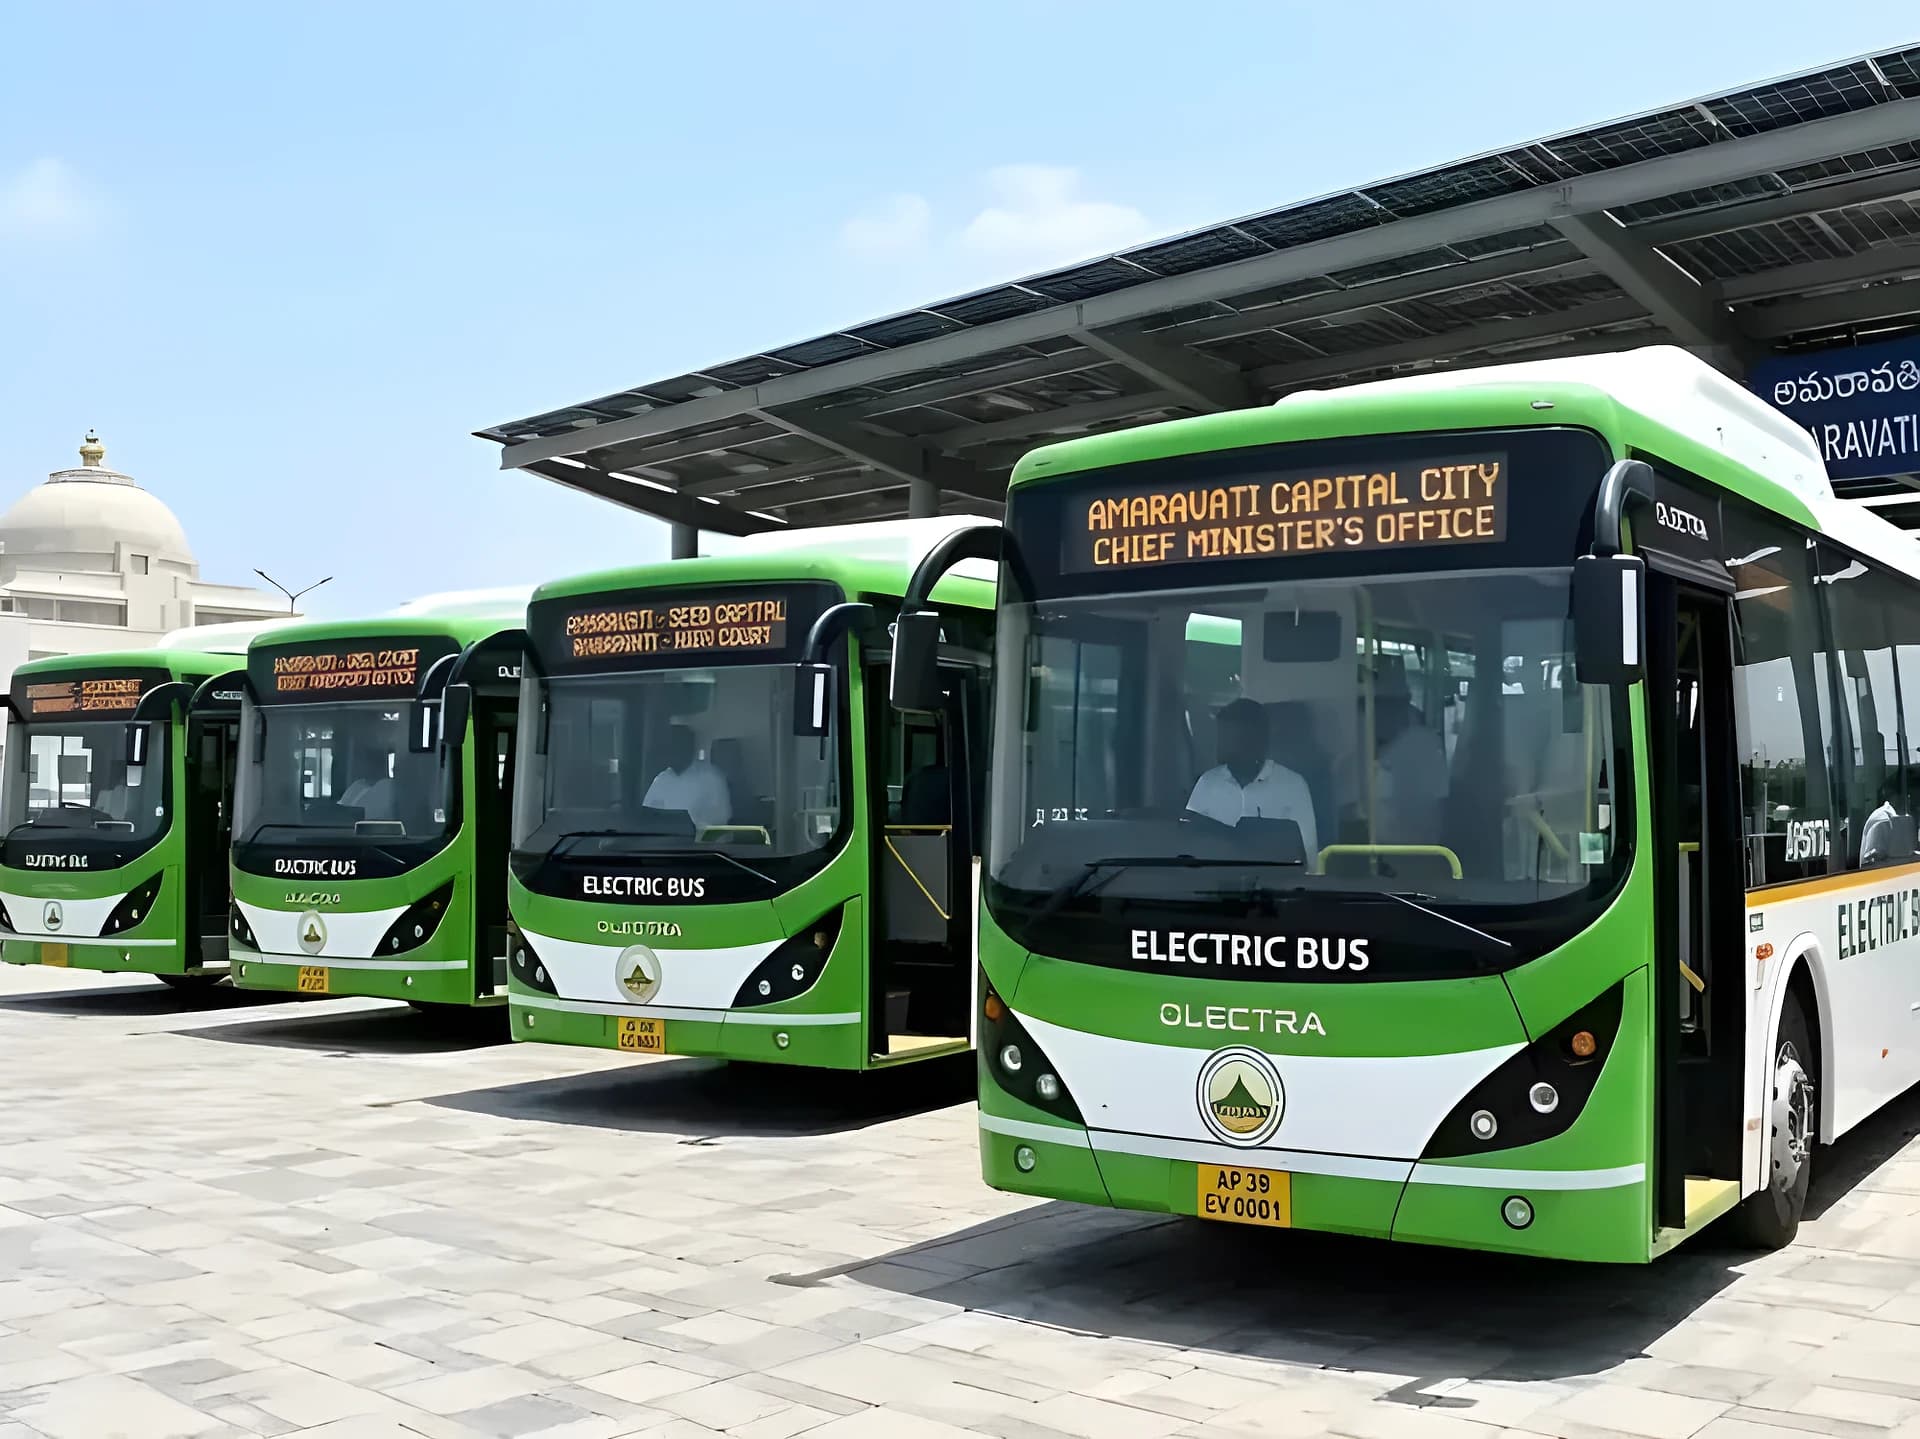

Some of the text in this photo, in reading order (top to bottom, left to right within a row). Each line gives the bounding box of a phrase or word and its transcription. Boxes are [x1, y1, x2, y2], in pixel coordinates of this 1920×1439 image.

[1811, 414, 1919, 461] RAVATI
[1271, 472, 1408, 515] CAPITAL
[1420, 462, 1500, 501] CITY
[1094, 505, 1495, 565] CHIEF MINISTER'S OFFICE
[583, 875, 705, 898] ELECTRIC BUS
[1131, 929, 1370, 971] ELECTRIC BUS
[1159, 1003, 1327, 1036] OLECTRA
[1217, 1170, 1270, 1194] AP 39
[1206, 1193, 1280, 1221] EV 0001
